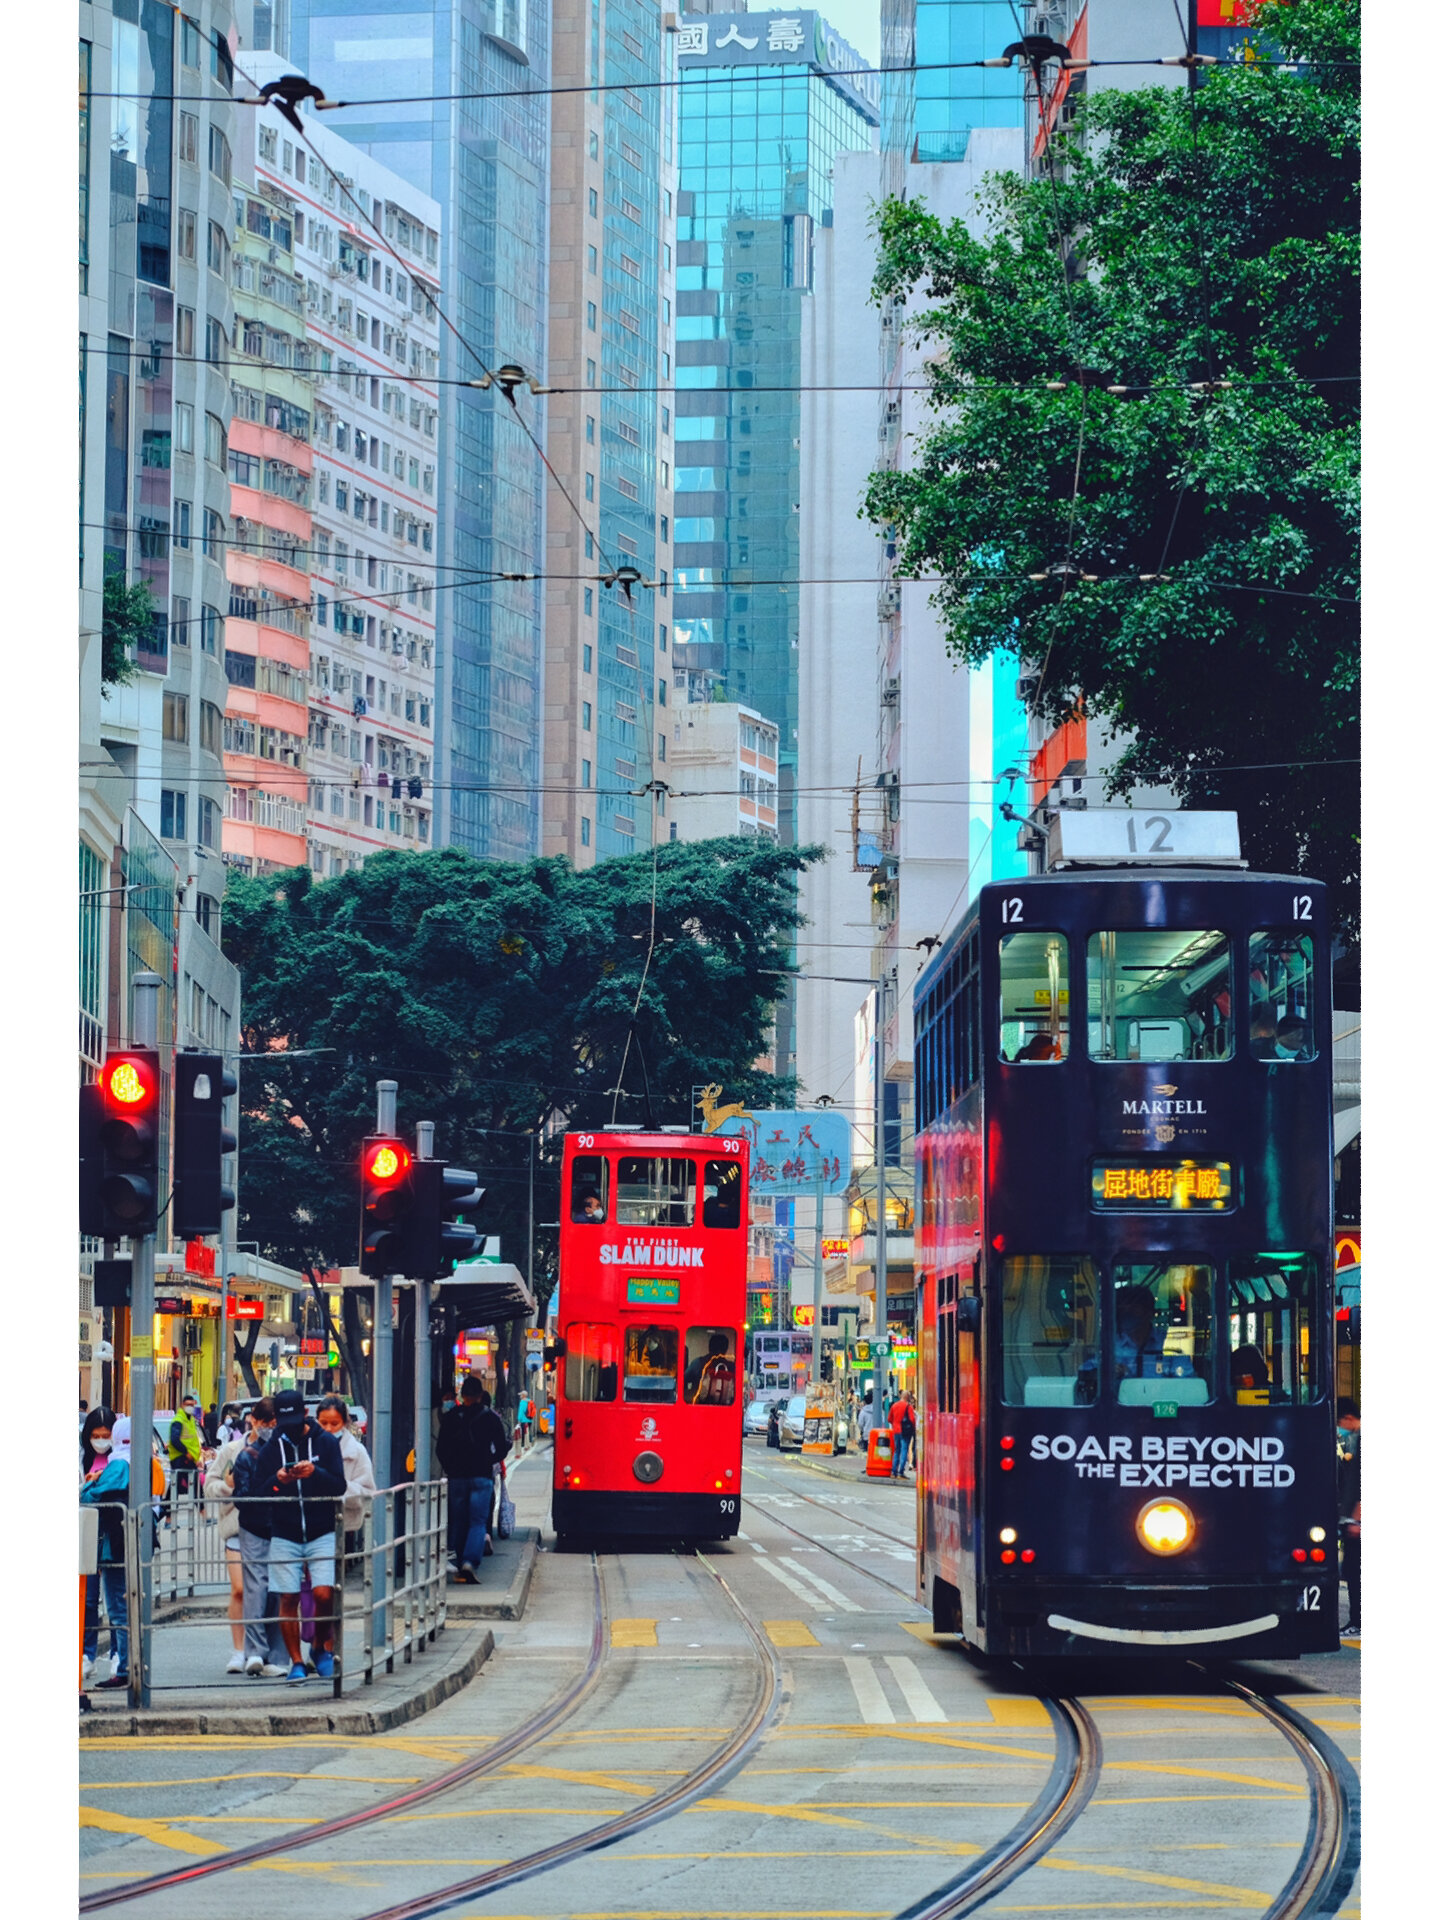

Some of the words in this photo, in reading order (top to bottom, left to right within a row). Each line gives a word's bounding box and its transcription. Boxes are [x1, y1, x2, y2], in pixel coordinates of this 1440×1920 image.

[1126, 815, 1174, 853] 12
[1002, 898, 1024, 923] 12
[1293, 895, 1313, 920] 12
[1122, 1100, 1207, 1114] MARTELL
[577, 1135, 595, 1149] 90
[723, 1140, 740, 1153] 90
[1103, 1168, 1221, 1199] 屈地街車廠
[626, 1237, 645, 1246] THE
[649, 1238, 679, 1247] FIRST
[599, 1244, 651, 1265] SLAM
[653, 1246, 704, 1267] DUNK
[630, 1278, 654, 1288] Happy
[657, 1279, 680, 1288] Valley
[1155, 1403, 1176, 1415] 126
[1029, 1435, 1132, 1460] SOAR
[1141, 1436, 1285, 1462] BEYOND
[1074, 1463, 1115, 1478] THE
[1120, 1464, 1296, 1488] EXPECTED
[720, 1499, 735, 1514] 90
[1303, 1585, 1321, 1611] 12
